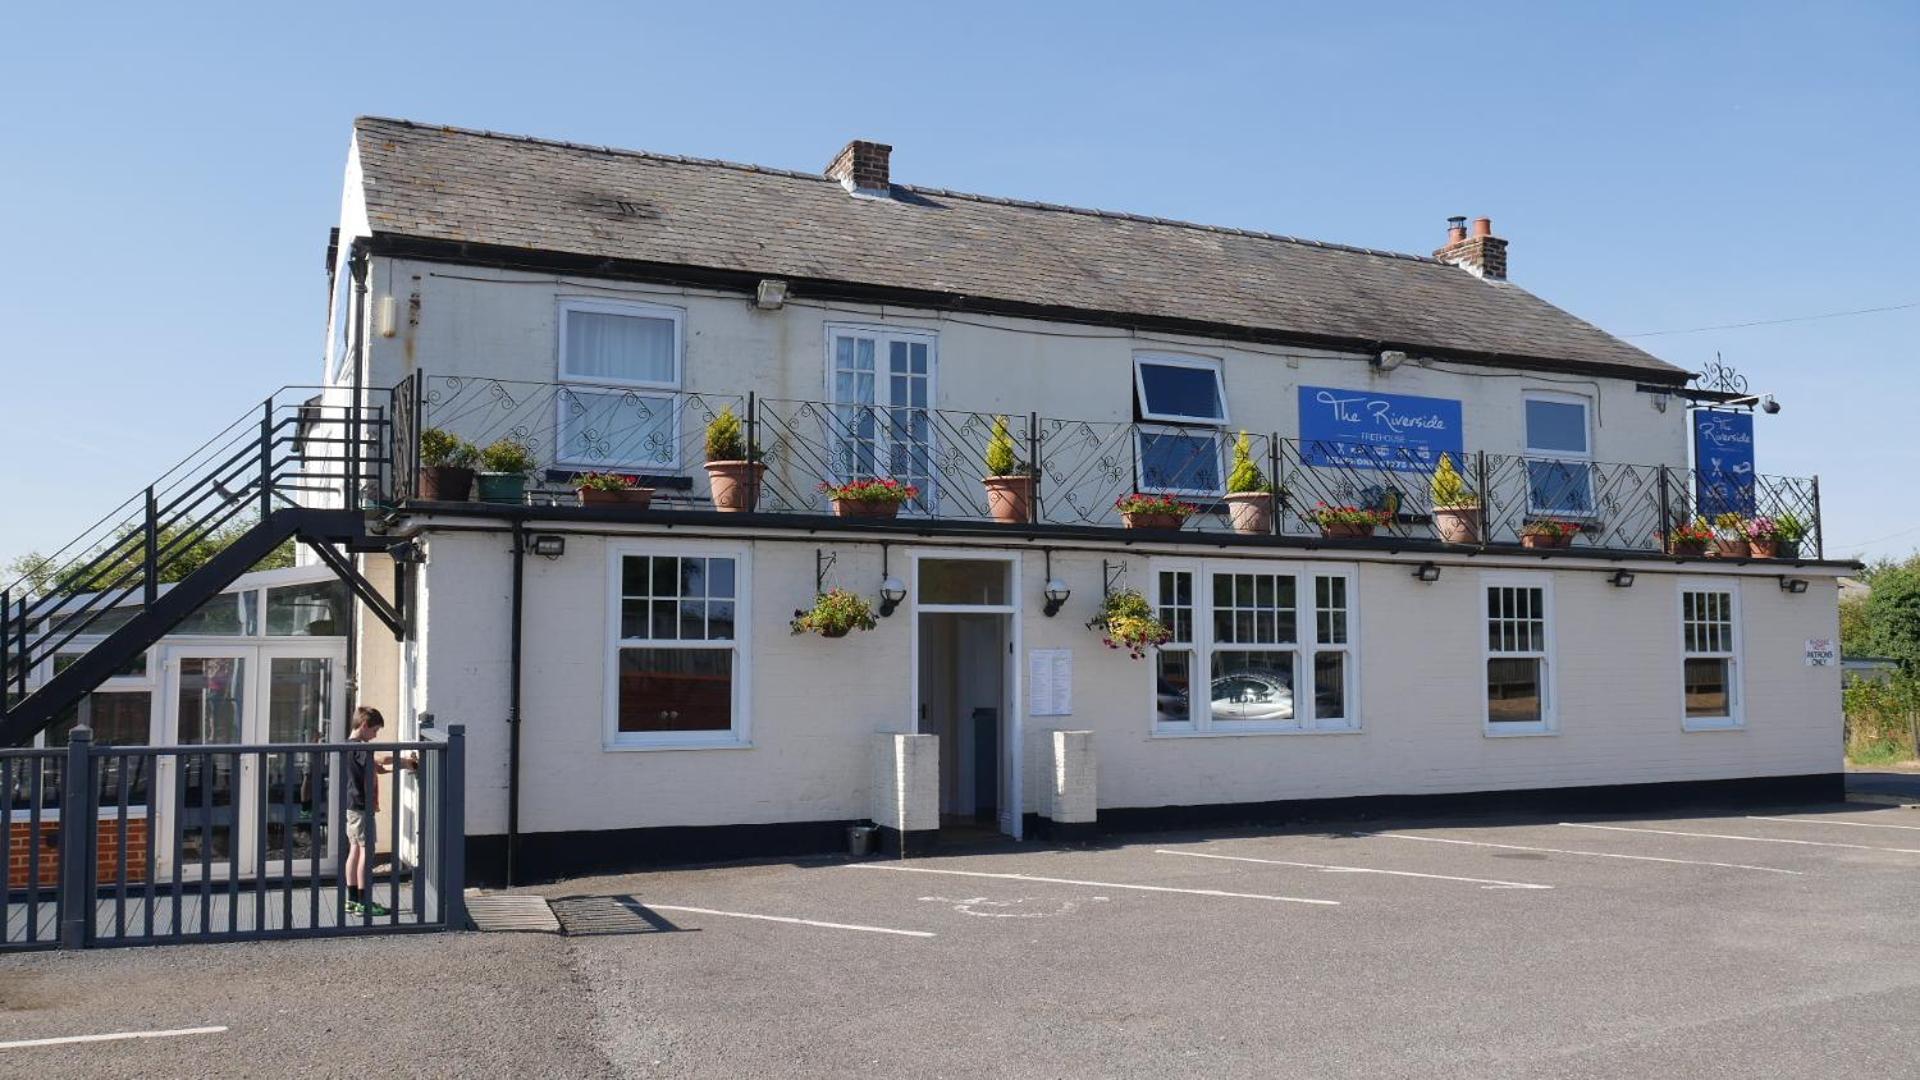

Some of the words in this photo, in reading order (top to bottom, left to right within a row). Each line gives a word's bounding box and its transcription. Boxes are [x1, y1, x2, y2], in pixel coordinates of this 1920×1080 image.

[1316, 391, 1367, 422] The
[1367, 401, 1446, 433] Riverside
[1699, 422, 1751, 446] Riverside
[1806, 650, 1833, 658] PATRONS
